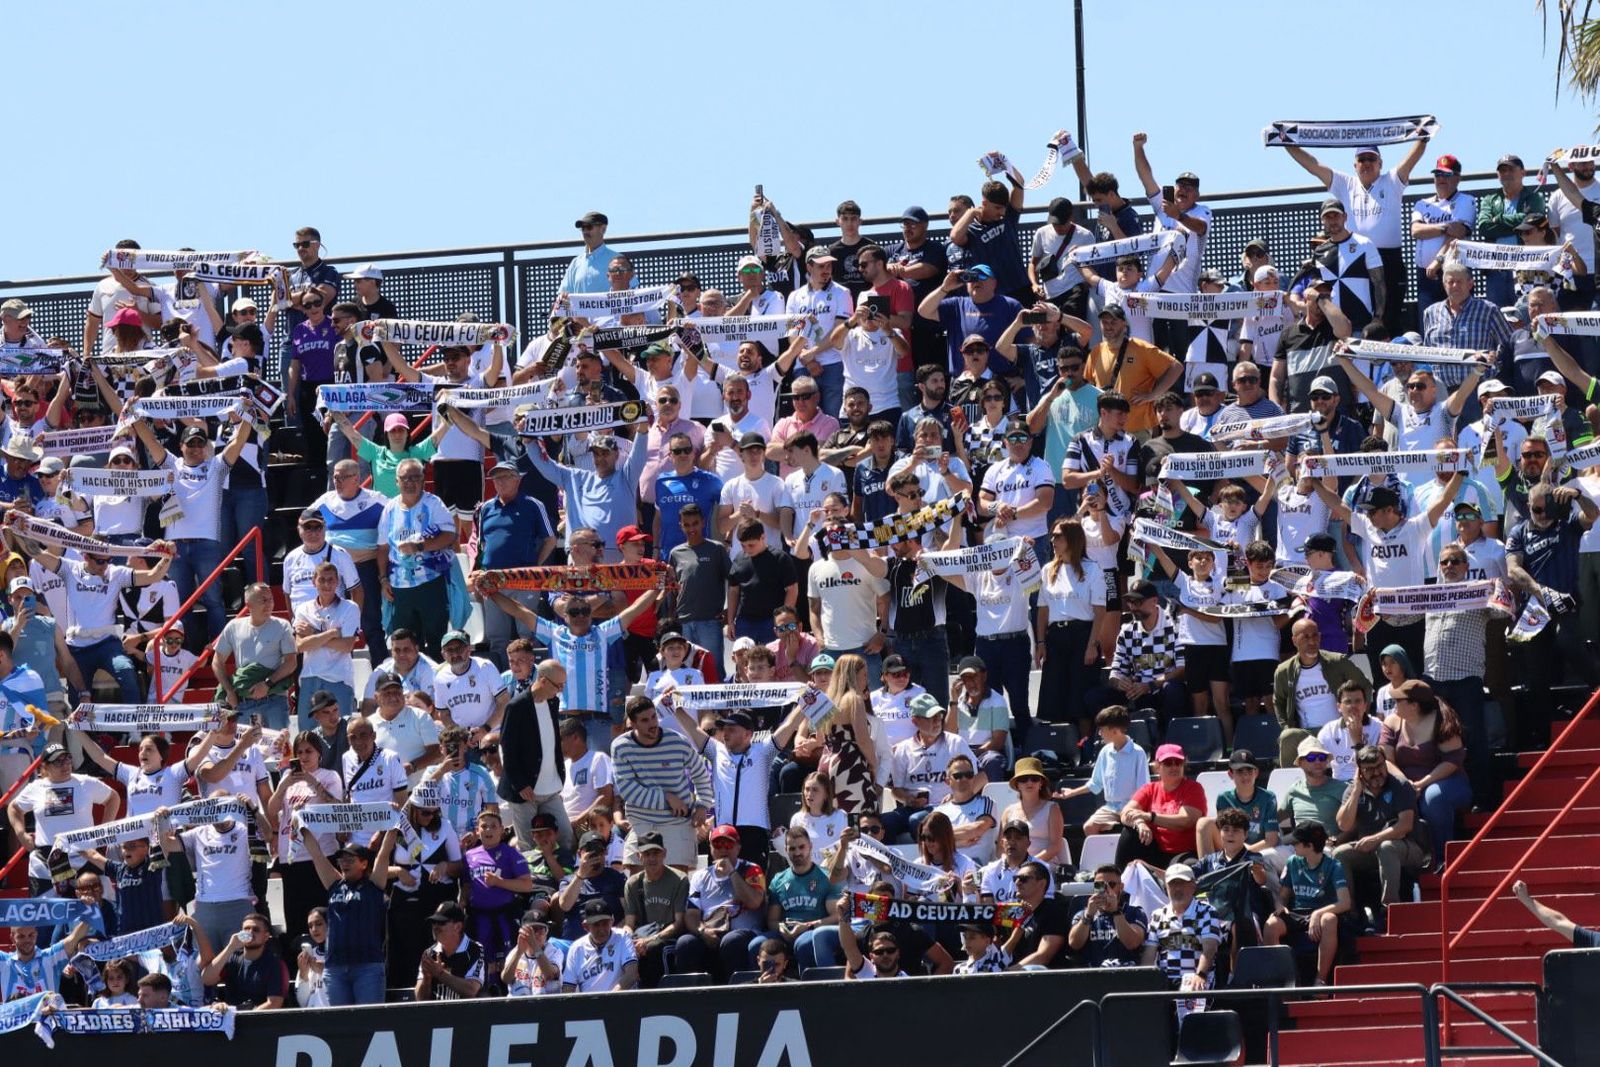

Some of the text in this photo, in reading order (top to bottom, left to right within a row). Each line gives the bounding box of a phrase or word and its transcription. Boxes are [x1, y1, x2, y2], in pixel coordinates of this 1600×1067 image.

[1298, 126, 1405, 140] ASOCIACION DEPORTIVA CEUTA
[1422, 212, 1453, 224] Ceuta
[145, 253, 230, 263] HACIENDO HISTORIA
[1466, 250, 1550, 262] HACIENDO HISTORIA
[218, 265, 258, 278] CEUTA
[579, 293, 663, 309] HACIENDO HISTORIA
[1157, 300, 1248, 312] HACIENDO HISTORIA
[610, 306, 633, 314] JUNTOS
[1188, 311, 1218, 319] SIGAMOS
[392, 325, 476, 342] AD CEUTA FC
[701, 321, 778, 335] ACIENDO HISTORIA
[297, 340, 329, 352] CEUTA
[459, 385, 541, 400] HACIENDO HISTORIA
[142, 397, 234, 411] HACIENDO HISTORIA
[176, 409, 200, 417] JUNTOS
[1516, 408, 1539, 416] JUNTOS
[89, 435, 104, 445] NOS
[1209, 458, 1254, 468] HACIENDO
[1336, 453, 1428, 466] HACIENDO HISTORIA
[1371, 464, 1395, 473] JUNTOS
[1194, 471, 1225, 479] SIGAMOS
[82, 477, 165, 488] HACIENDO HISTORIA
[996, 478, 1030, 493] Ceuta
[113, 488, 138, 496] JUNTOS
[31, 524, 48, 535] UNA
[48, 527, 82, 542] ILUSION
[962, 548, 994, 557] SIGAMOS
[1371, 544, 1408, 558] CEUTA
[933, 554, 980, 567] HACIENDO
[966, 562, 993, 572] JUNTOS
[76, 583, 109, 594] CEUTA
[819, 576, 861, 589] ellesse
[980, 596, 1011, 606] ceuta
[1380, 589, 1487, 604] UNA ILUSION NOS PERSIGUE
[691, 688, 788, 701] HACIENDO HISTORIA
[1296, 684, 1334, 698] CEUTA
[447, 694, 481, 708] CEUTA
[726, 699, 752, 708] JUNTOS
[104, 712, 194, 723] HACIENDO HISTORIA
[136, 722, 161, 730] JUNTOS
[332, 804, 362, 812] SIGAMOS
[303, 810, 391, 823] HACIENDO HISTORIA
[67, 820, 144, 843] HACIENDO HISTORIA
[338, 823, 364, 831] JUNTOS
[204, 845, 237, 855] CEUTA
[782, 897, 818, 911] CEUTA
[890, 905, 994, 920] AD CEUTA FC
[66, 1014, 135, 1030] PADRES
[153, 1013, 167, 1029] A
[172, 1011, 223, 1028] HIJOS
